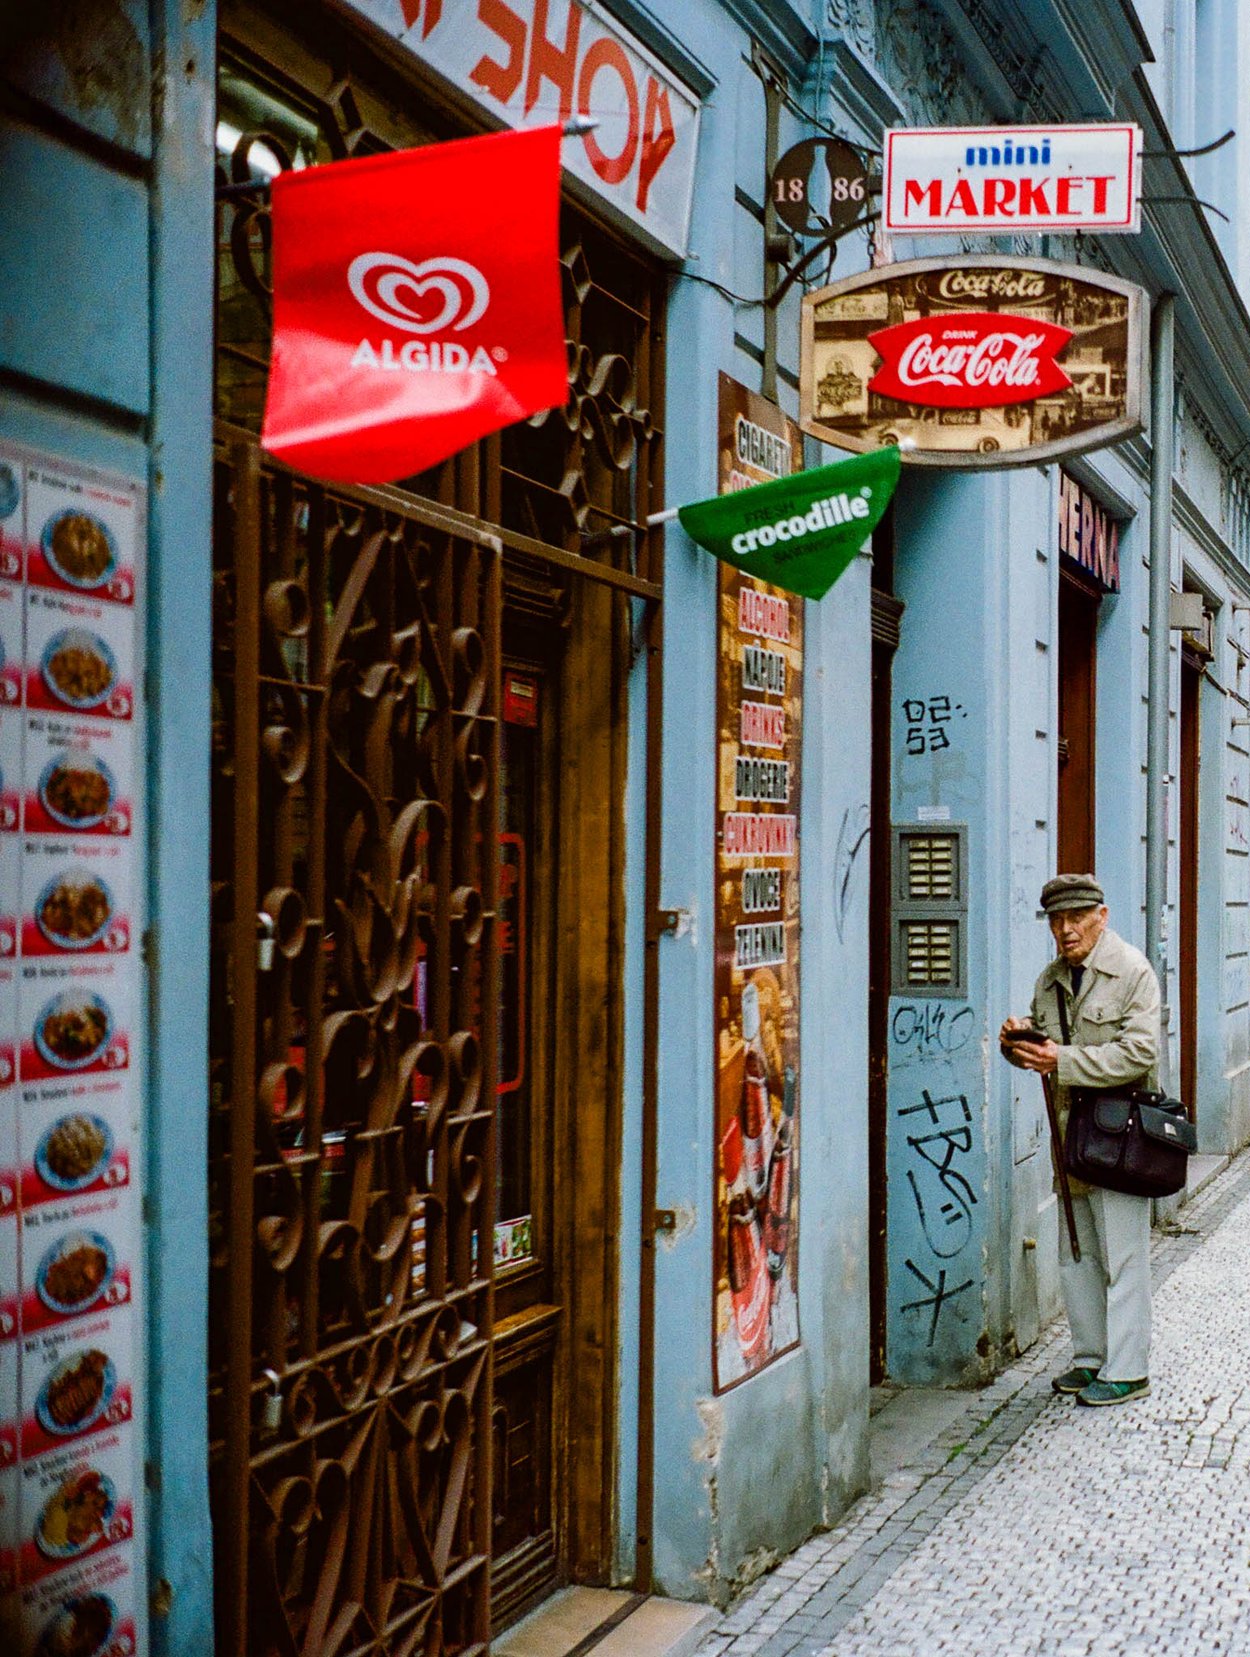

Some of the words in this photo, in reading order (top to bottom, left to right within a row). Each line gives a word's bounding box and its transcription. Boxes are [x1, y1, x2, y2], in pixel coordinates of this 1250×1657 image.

[468, 0, 676, 214] SHOP
[965, 139, 1051, 167] mini
[774, 178, 803, 202] 18
[833, 176, 865, 201] 86
[903, 176, 1116, 218] MARKET
[942, 329, 978, 340] DRINK
[351, 337, 498, 377] ALGIDA
[897, 332, 1045, 387] Coca-Cola
[731, 492, 870, 555] crocodille
[740, 589, 789, 643] ALCOHOL
[743, 703, 784, 747] DRINKS
[736, 759, 788, 801] DROGERIE
[745, 871, 779, 911] OVOCE
[737, 924, 786, 968] ZELENINA
